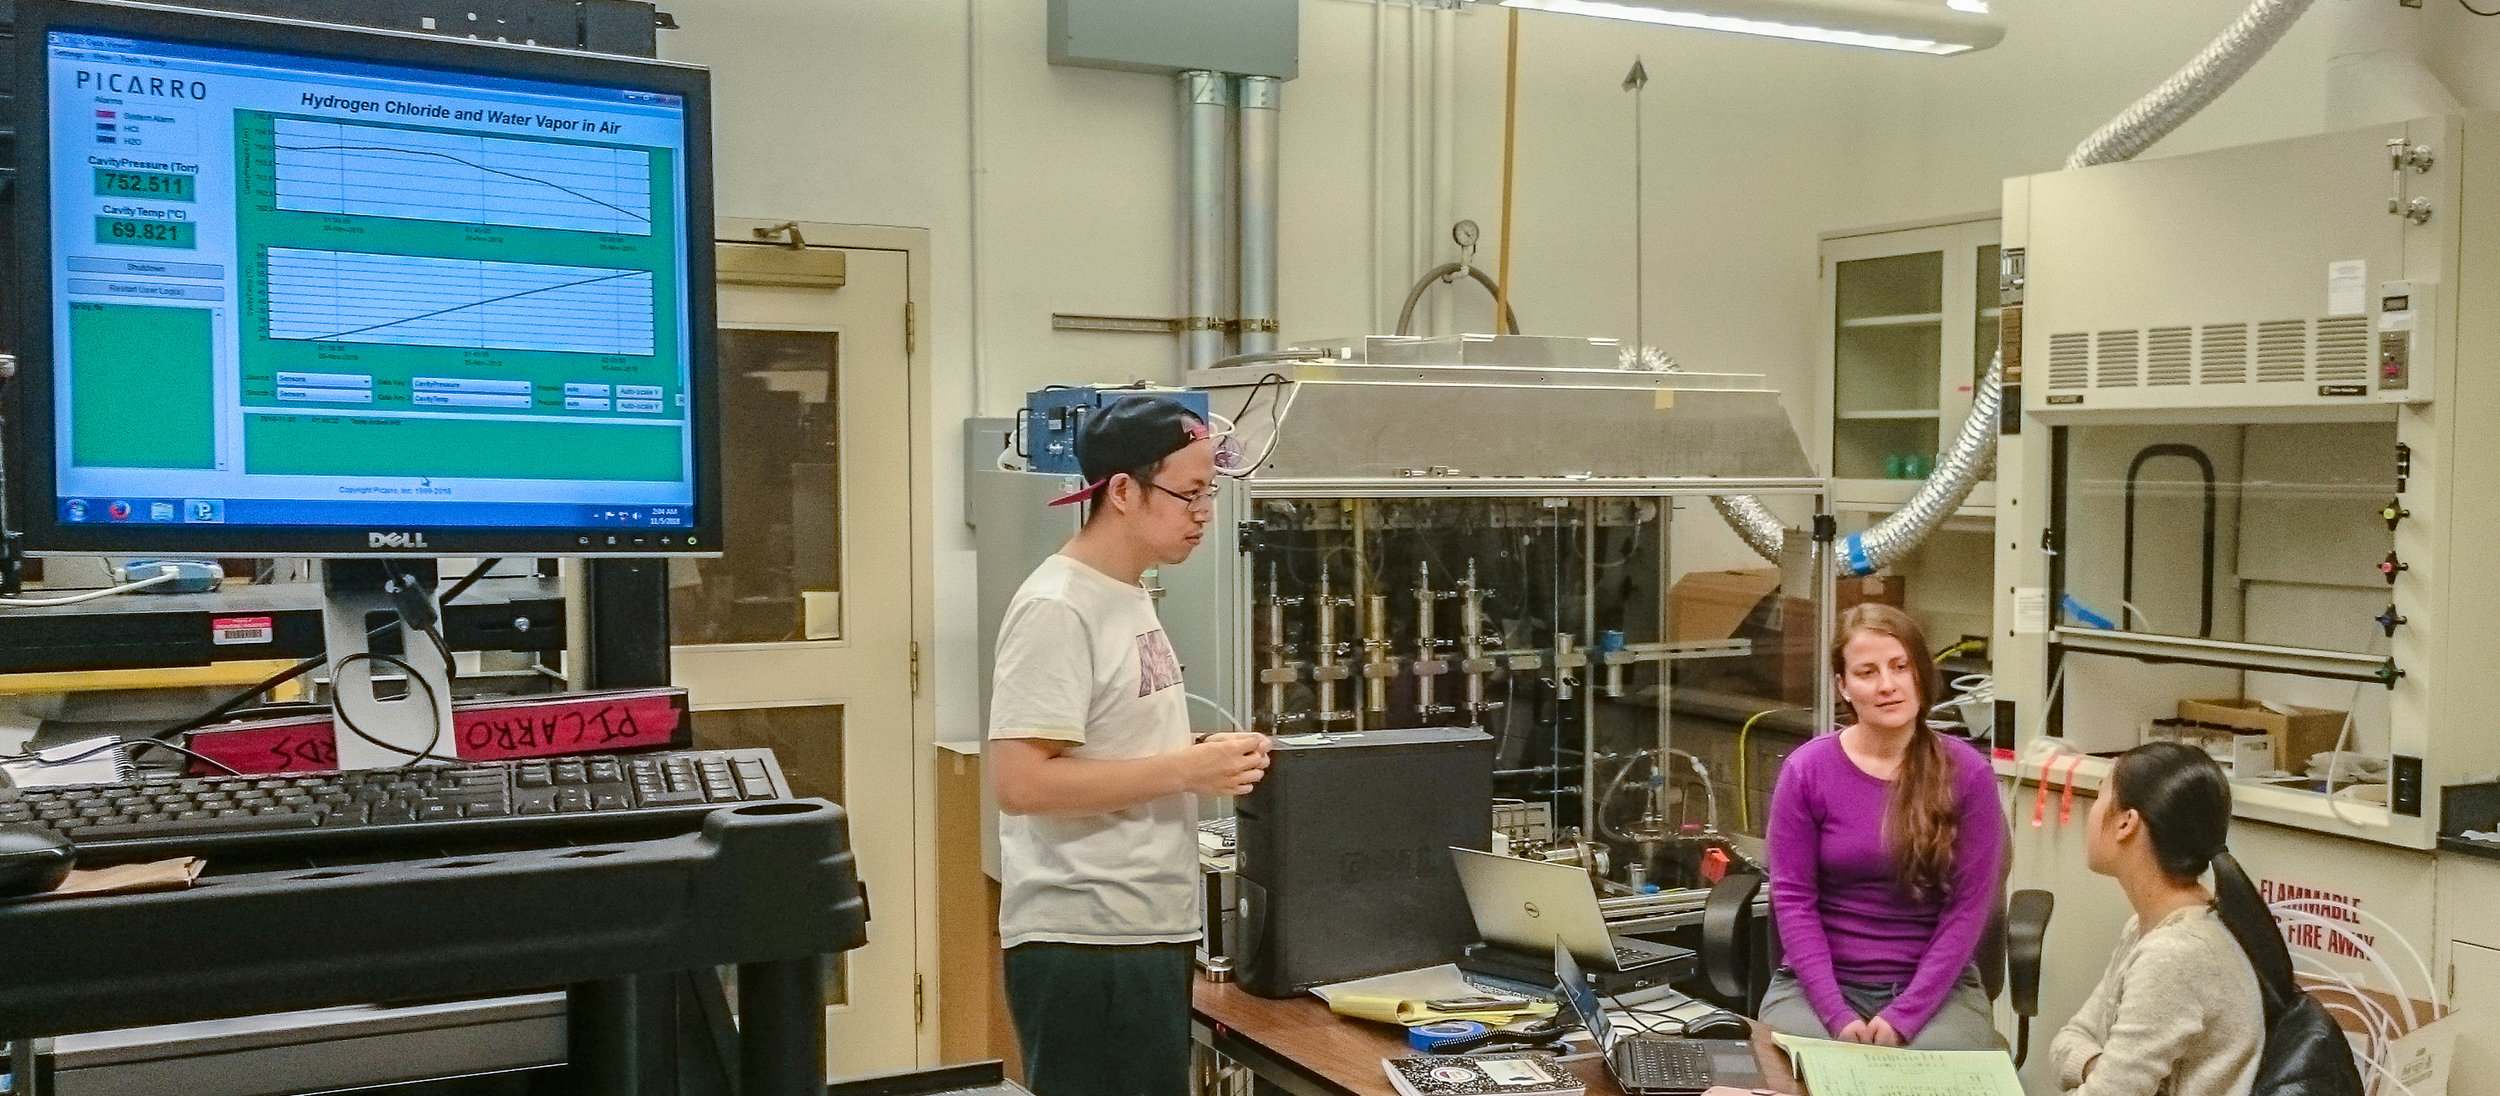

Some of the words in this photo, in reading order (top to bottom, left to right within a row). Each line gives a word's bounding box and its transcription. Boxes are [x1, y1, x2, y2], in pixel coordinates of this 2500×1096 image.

[76, 70, 206, 100] PICARRO
[301, 92, 379, 113] Hydrogen
[385, 100, 450, 119] Chloride
[454, 108, 483, 122] and
[487, 110, 532, 127] Water
[536, 114, 579, 132] Vapor
[582, 119, 595, 132] in
[600, 121, 622, 135] Air
[88, 155, 169, 171] CavityPressure
[170, 161, 199, 174] (Torr)
[105, 173, 183, 195] 752.511
[112, 221, 178, 241] 69.821
[127, 263, 166, 272] Shutdown
[339, 486, 372, 495] Copyright
[650, 517, 681, 525] 11/5/2018
[368, 532, 428, 549] DELL
[466, 705, 640, 752] PICARRO
[2288, 918, 2323, 951] FIRE
